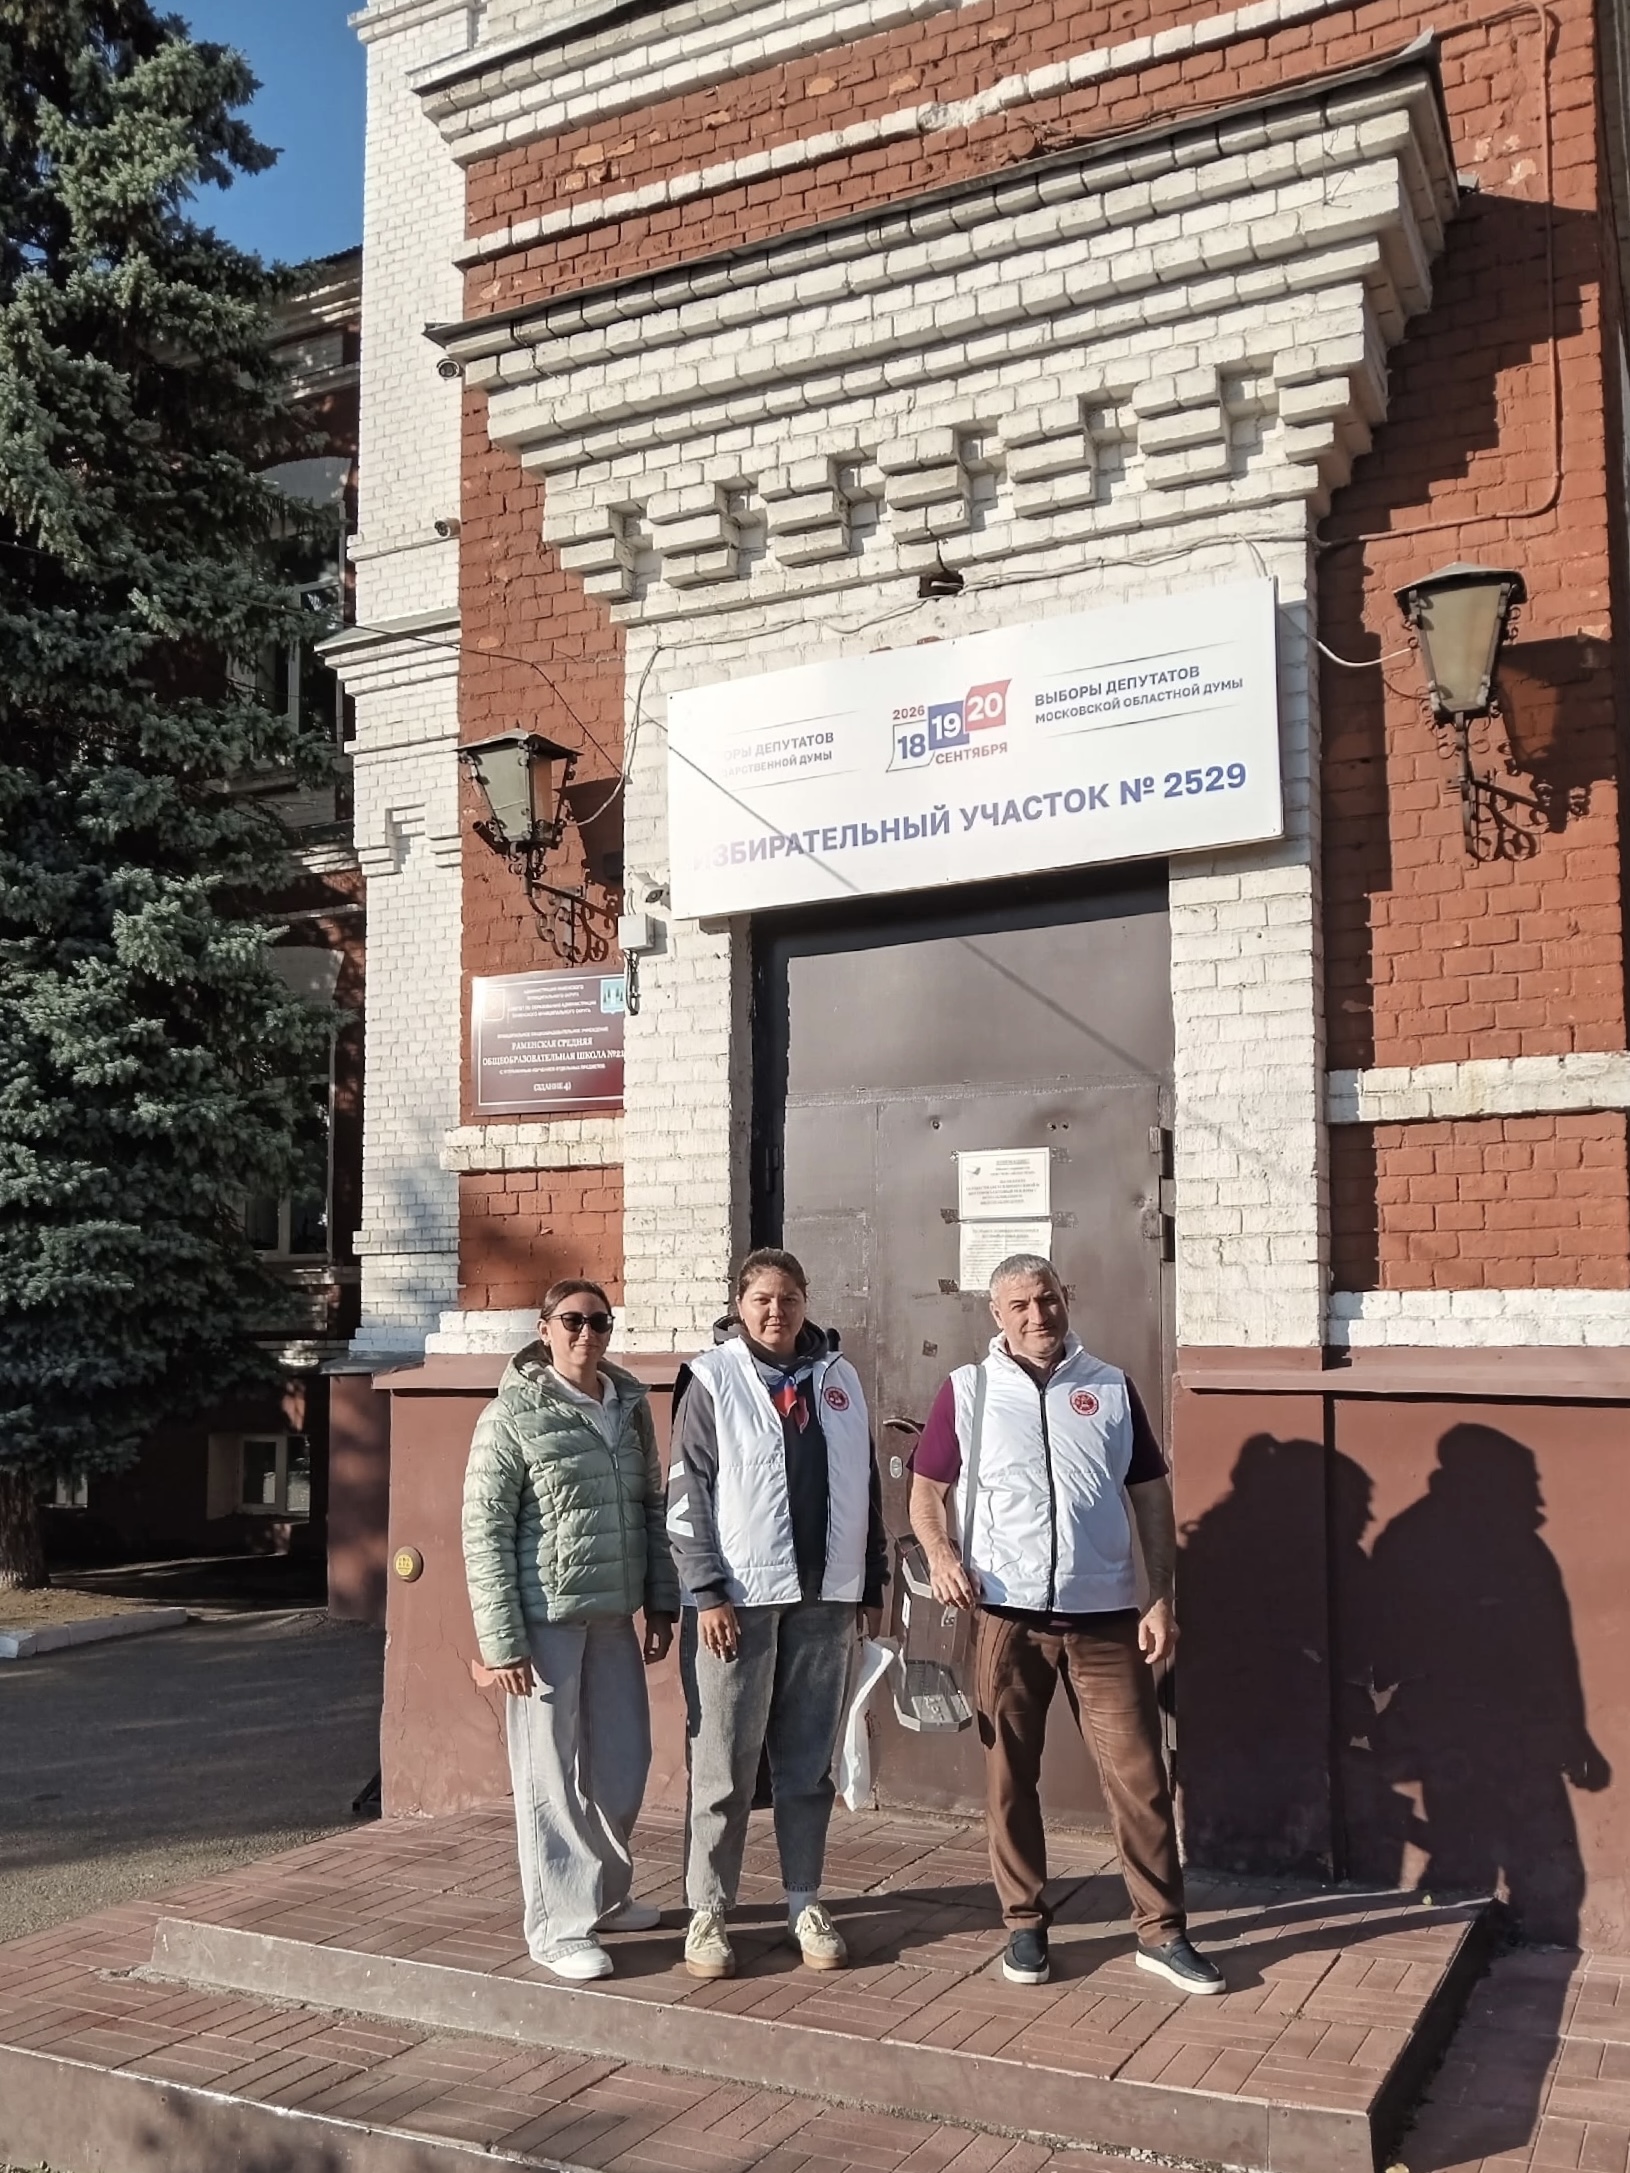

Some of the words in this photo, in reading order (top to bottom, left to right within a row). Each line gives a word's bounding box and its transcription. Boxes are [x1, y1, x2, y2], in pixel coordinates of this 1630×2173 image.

[1035, 683, 1102, 706] ВЫБОРЫ
[1106, 666, 1200, 695] ДЕПУТАТОВ
[892, 705, 925, 720] 2026
[1035, 698, 1121, 724] МОСКОВСКОЙ
[1123, 684, 1200, 708] ОБЛАСТНОЙ
[1202, 678, 1243, 696] ДУМЫ
[897, 733, 926, 759] 18
[931, 712, 962, 740] 19
[967, 692, 1003, 722] 20
[755, 732, 834, 757] ДЕПУТАТОВ
[935, 742, 1008, 764] СЕНТЯБРЯ
[722, 754, 797, 778] ДАРСТВЕННОЙ
[799, 750, 832, 766] ДУМЫ
[960, 783, 1110, 831] УЧАСТОК
[1119, 776, 1155, 805] №
[1163, 762, 1247, 799] 2529
[482, 1052, 577, 1066] ОБЩЕОБРАЗОВАТЕЛЬНАЯ
[576, 1050, 606, 1060] ШКОЛА
